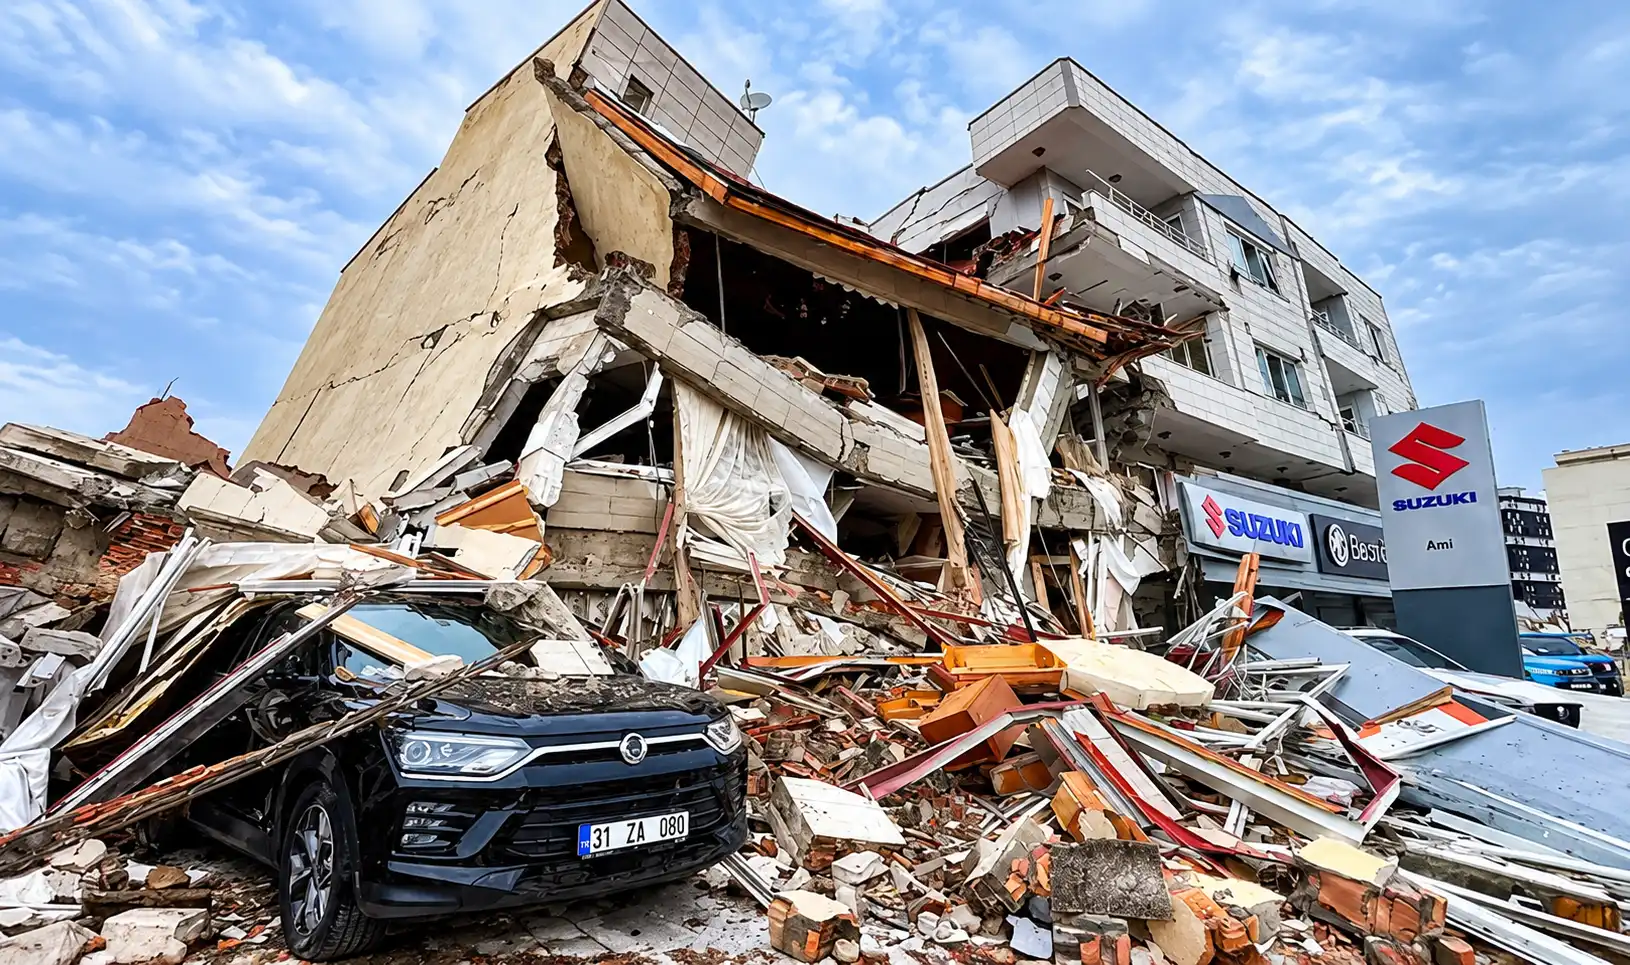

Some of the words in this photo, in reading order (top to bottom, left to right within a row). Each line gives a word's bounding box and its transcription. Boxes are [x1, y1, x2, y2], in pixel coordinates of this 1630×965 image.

[1392, 491, 1477, 512] SUZUKI
[1224, 508, 1304, 548] SUZUKI
[1426, 538, 1454, 551] Ami
[593, 826, 610, 849] 31
[626, 820, 646, 844] ZA
[660, 814, 685, 838] 080
